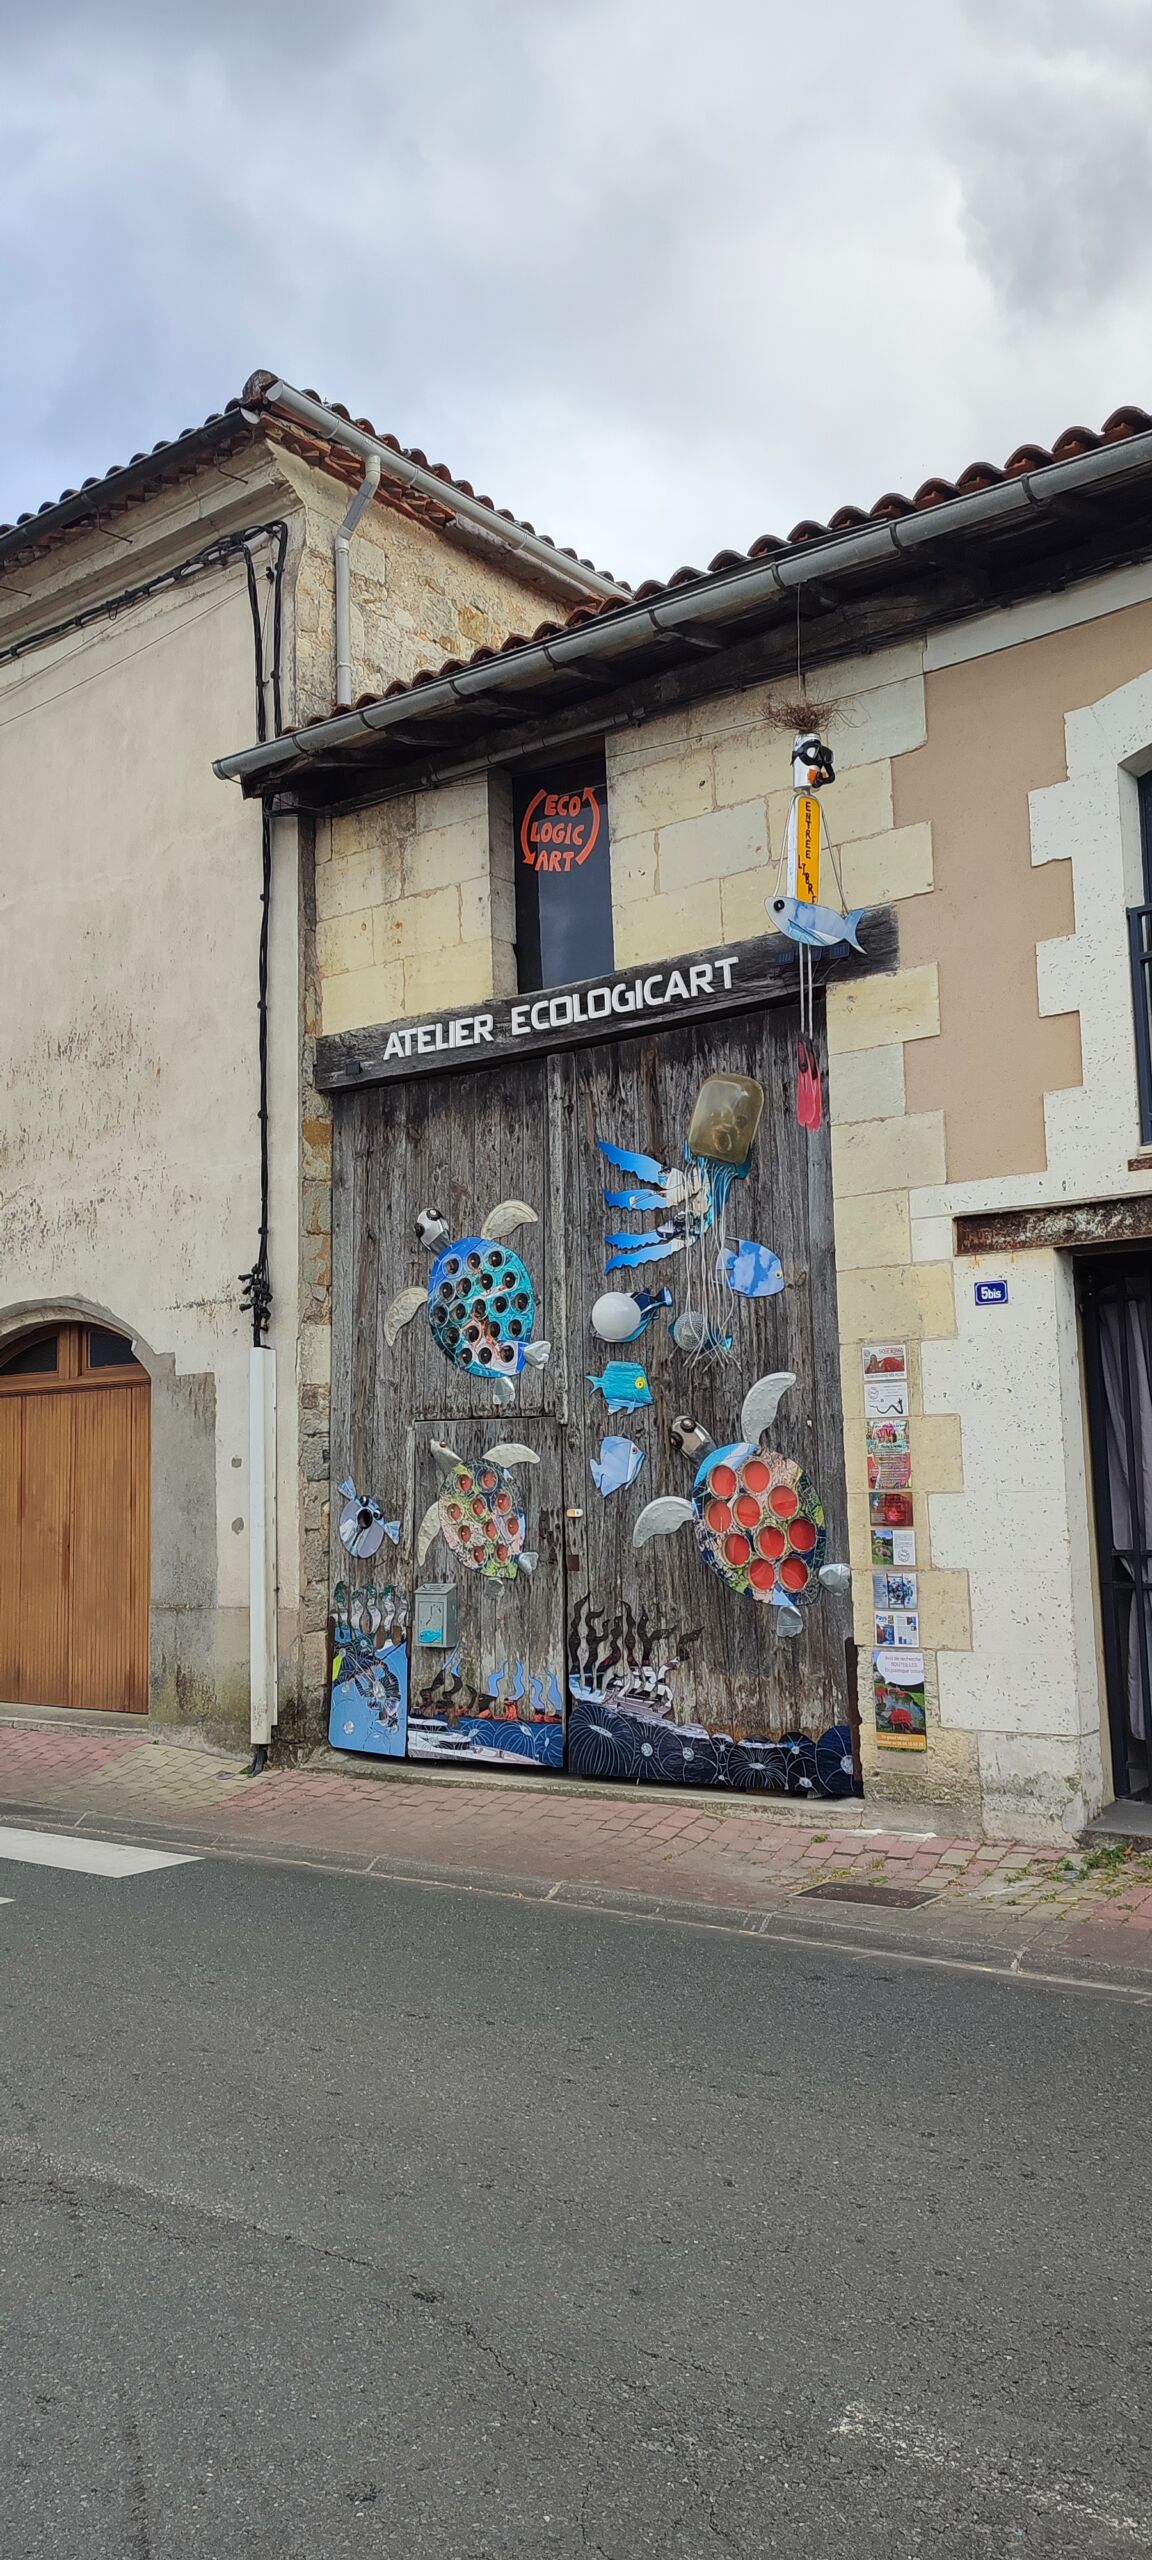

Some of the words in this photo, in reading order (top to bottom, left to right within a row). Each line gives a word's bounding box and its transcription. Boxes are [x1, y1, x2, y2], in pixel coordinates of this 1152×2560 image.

[544, 794, 581, 817] ECO
[530, 822, 585, 845] LOGIC
[805, 801, 813, 859] ENTREE
[535, 850, 575, 872] ART
[383, 1014, 495, 1061] ATELIER
[511, 956, 739, 1036] ECOLOGICART
[981, 1286, 1001, 1299] 5bis
